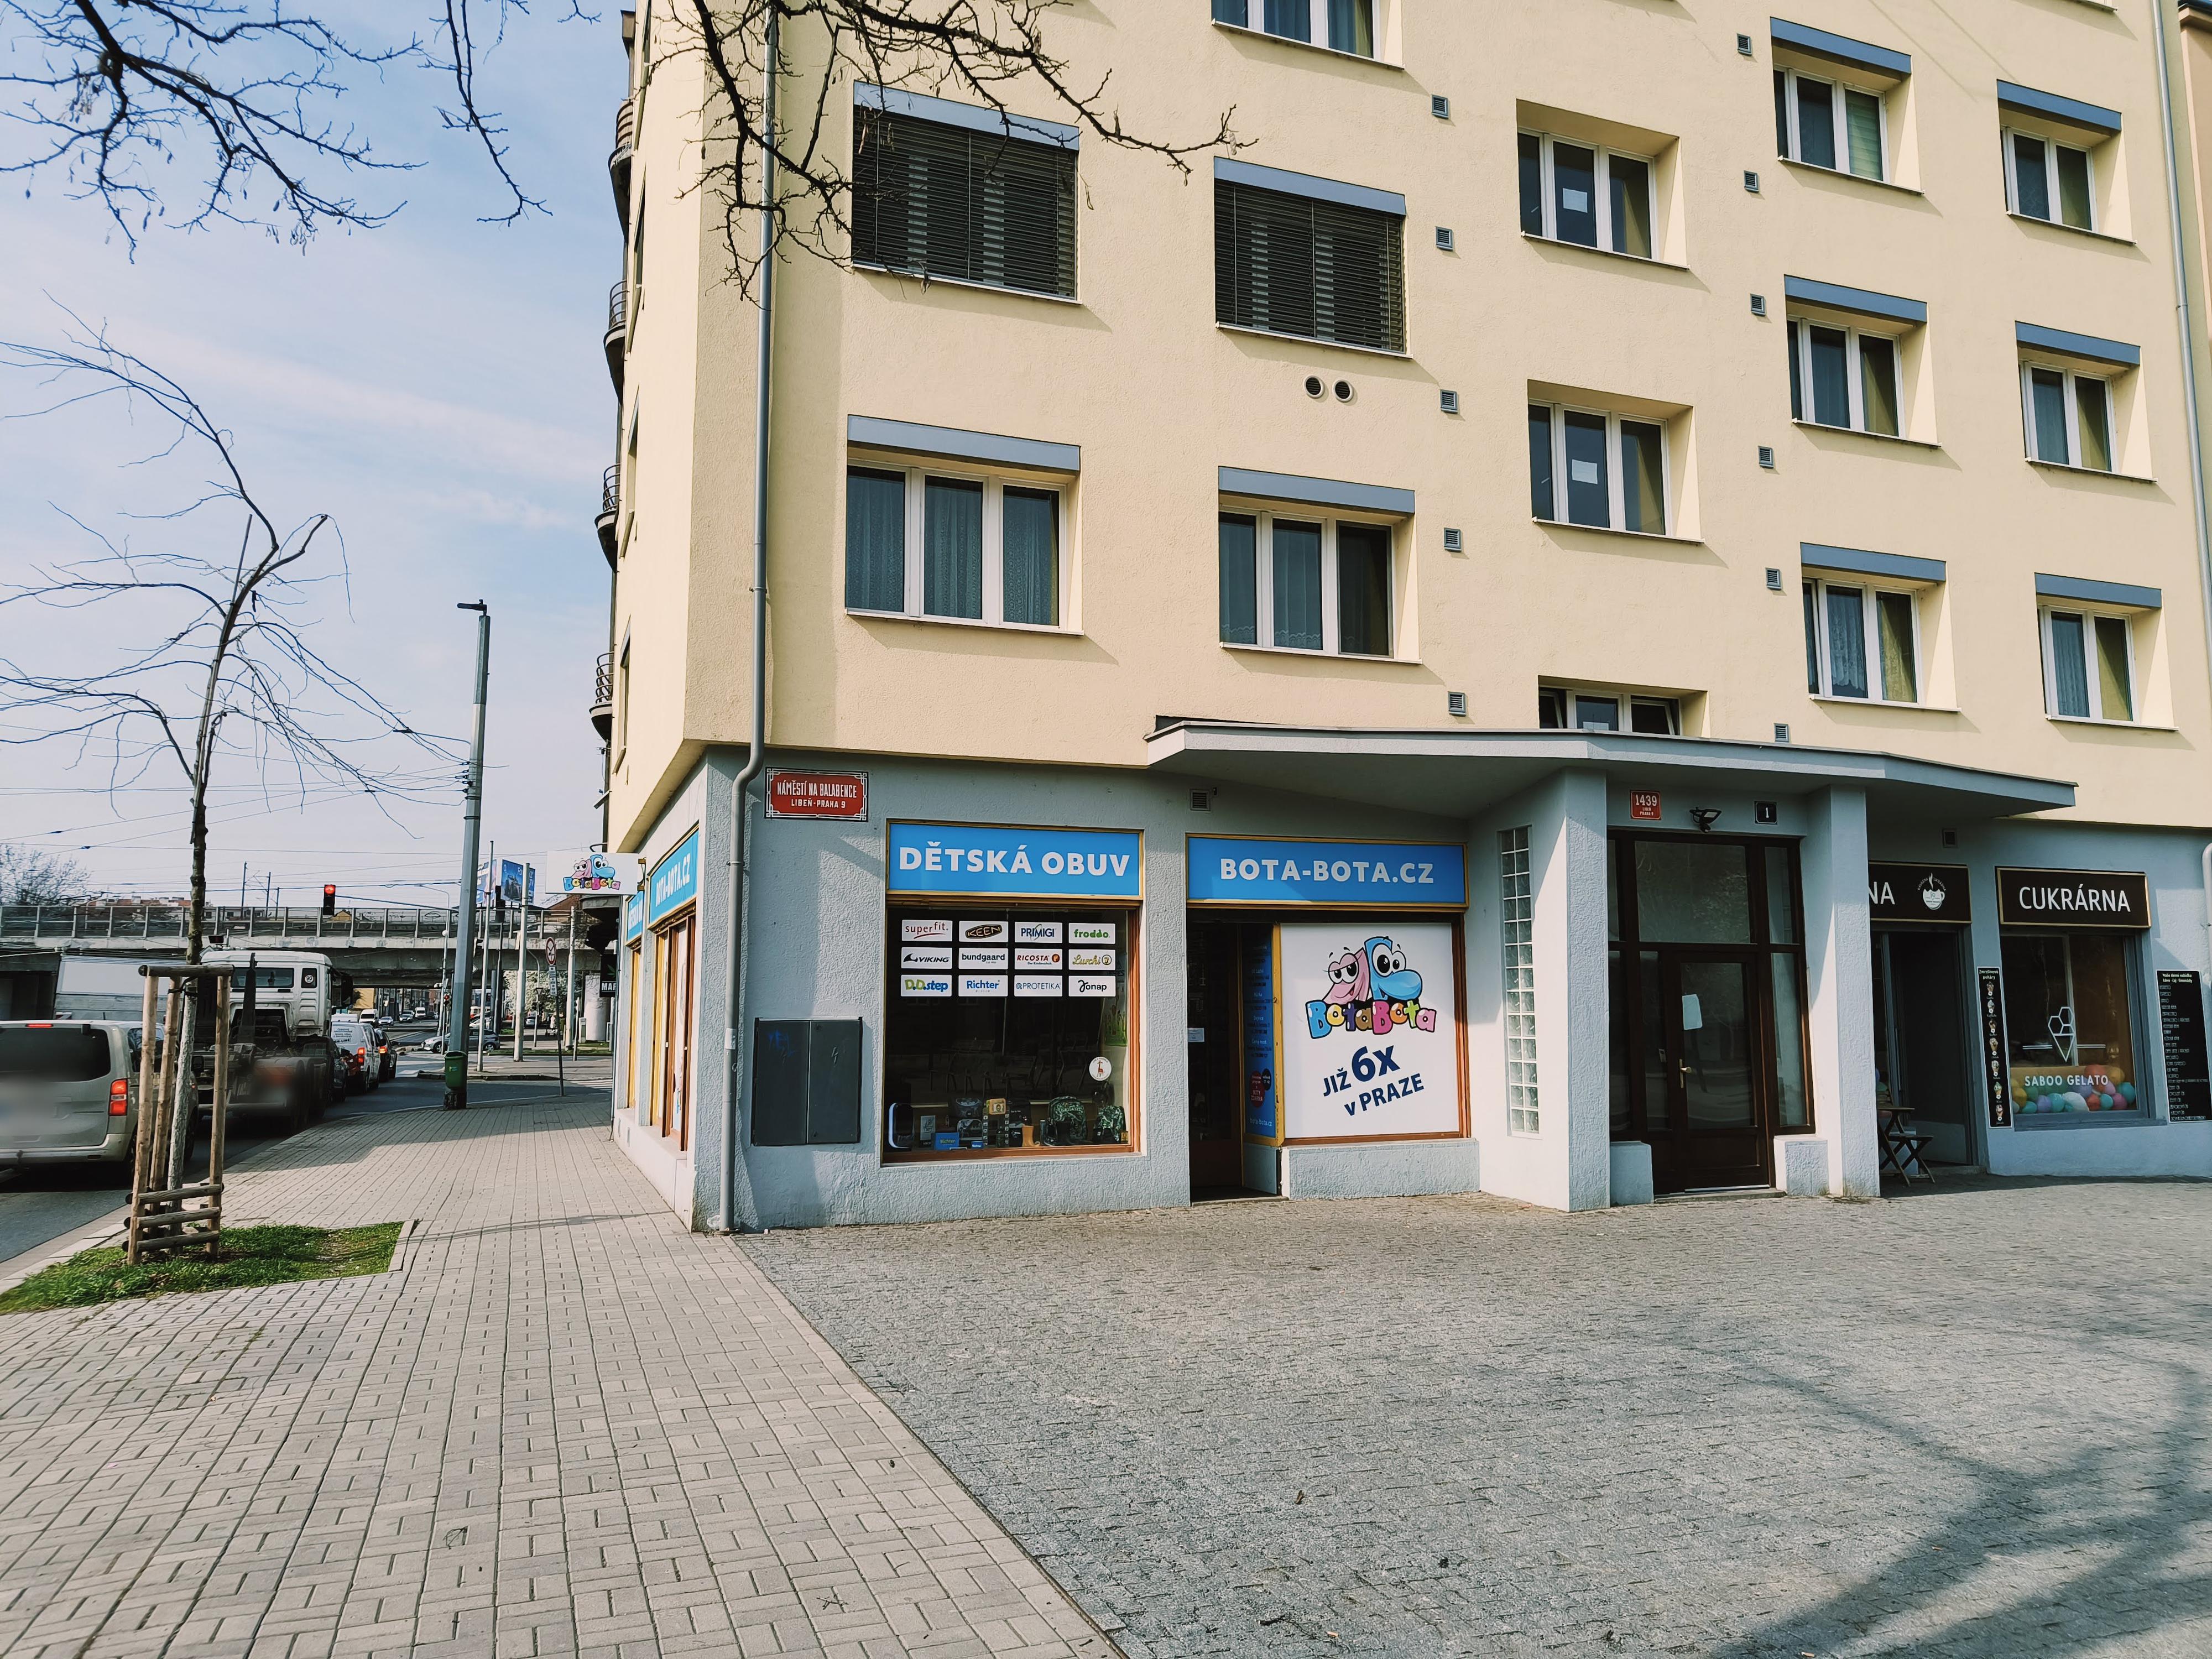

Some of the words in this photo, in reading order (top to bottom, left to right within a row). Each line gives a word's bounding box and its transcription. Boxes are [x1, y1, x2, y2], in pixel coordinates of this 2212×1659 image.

[777, 780, 807, 796] NÁMĚSTÍ
[808, 783, 818, 796] NA
[820, 784, 857, 798] BALABENCE
[1635, 794, 1657, 806] 1439
[1765, 807, 1769, 818] 1
[899, 841, 1032, 874] DĚTSKÁ
[1041, 852, 1130, 876] OBUV
[1220, 858, 1434, 884] BOTA-BOTA.CZ
[2019, 884, 2131, 912] CUKRÁRNA
[967, 926, 1000, 936] KEEN
[1021, 928, 1055, 937] PRIMIGI
[962, 953, 1005, 962] bundgaard
[966, 979, 999, 989] Richter
[1305, 999, 1437, 1040] BotaBota
[1323, 1067, 1352, 1097] JIŽ
[2025, 1075, 2063, 1087] SABOO
[2067, 1074, 2109, 1086] GELATO
[1359, 1073, 1425, 1112] PRAZE
